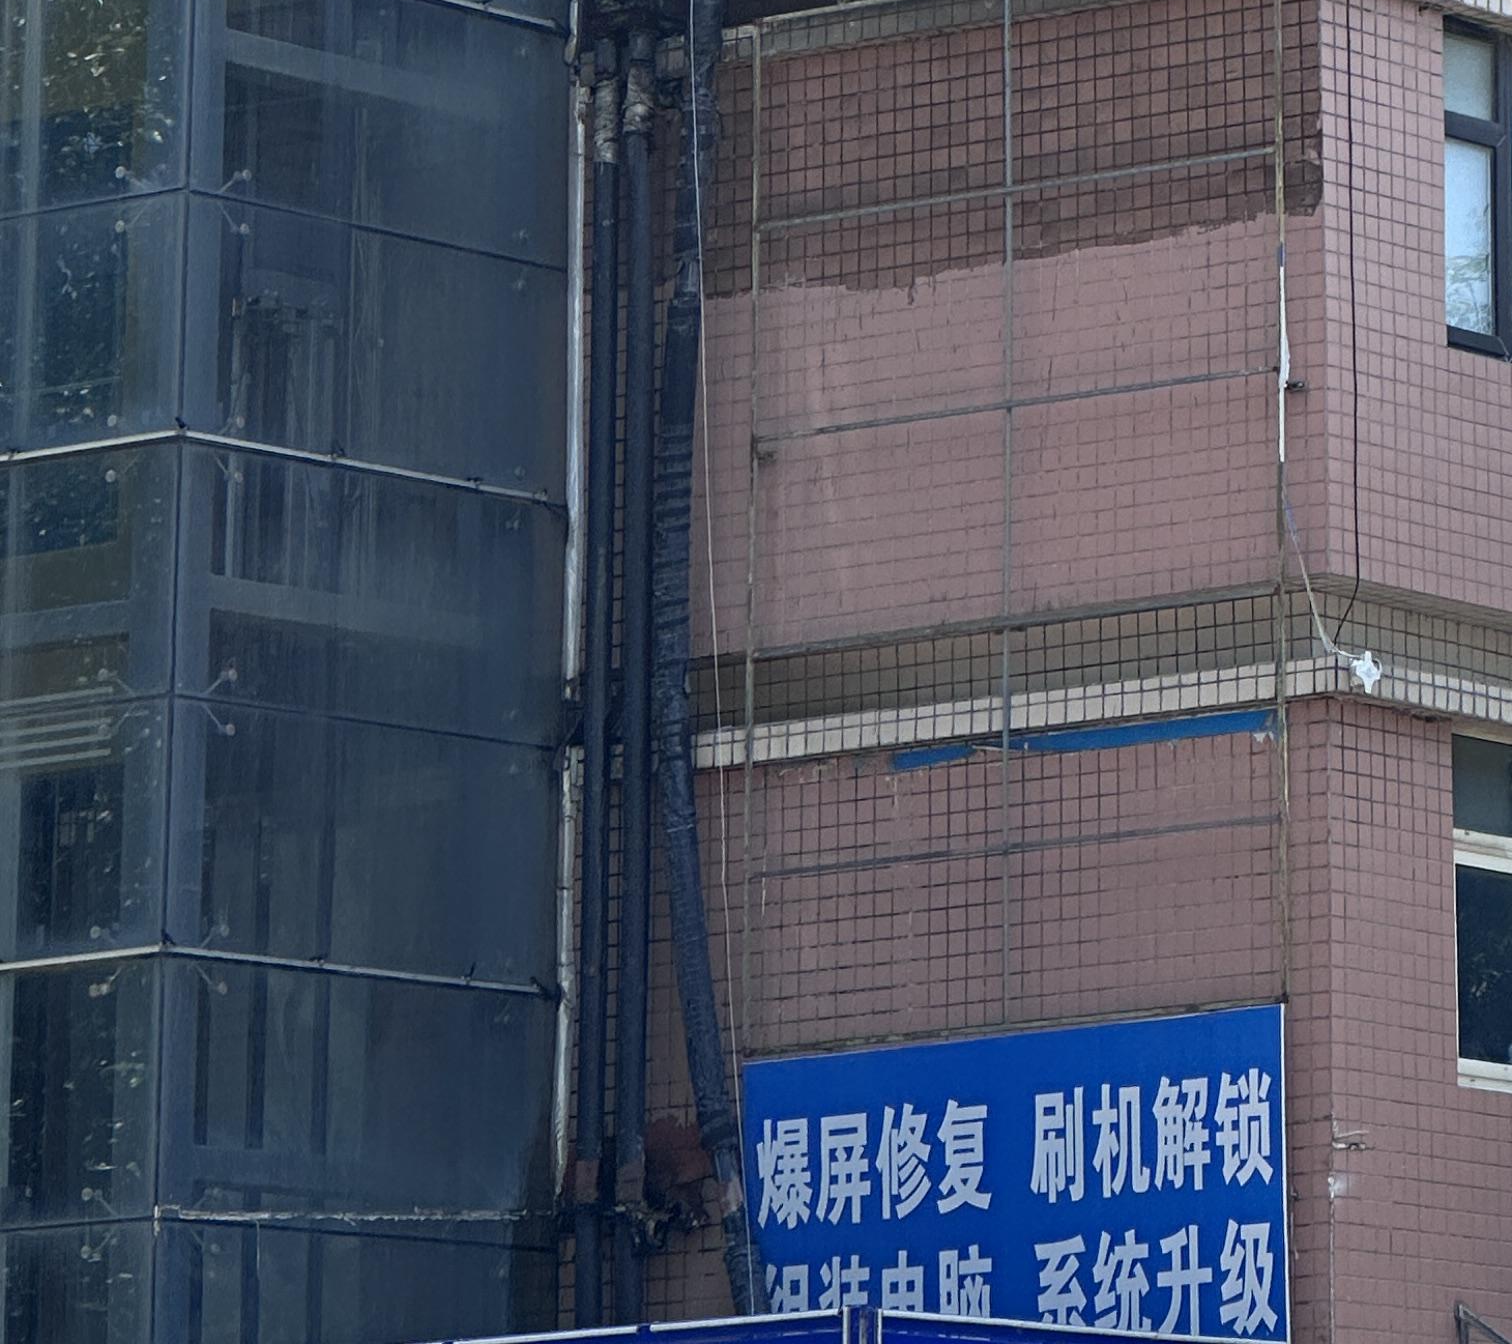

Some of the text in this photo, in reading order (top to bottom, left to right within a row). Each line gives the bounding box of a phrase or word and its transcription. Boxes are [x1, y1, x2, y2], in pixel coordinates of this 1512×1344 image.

[757, 1067, 1274, 1230] 爆屏修复 刷机解锁
[1034, 1219, 1279, 1336] 系统升级
